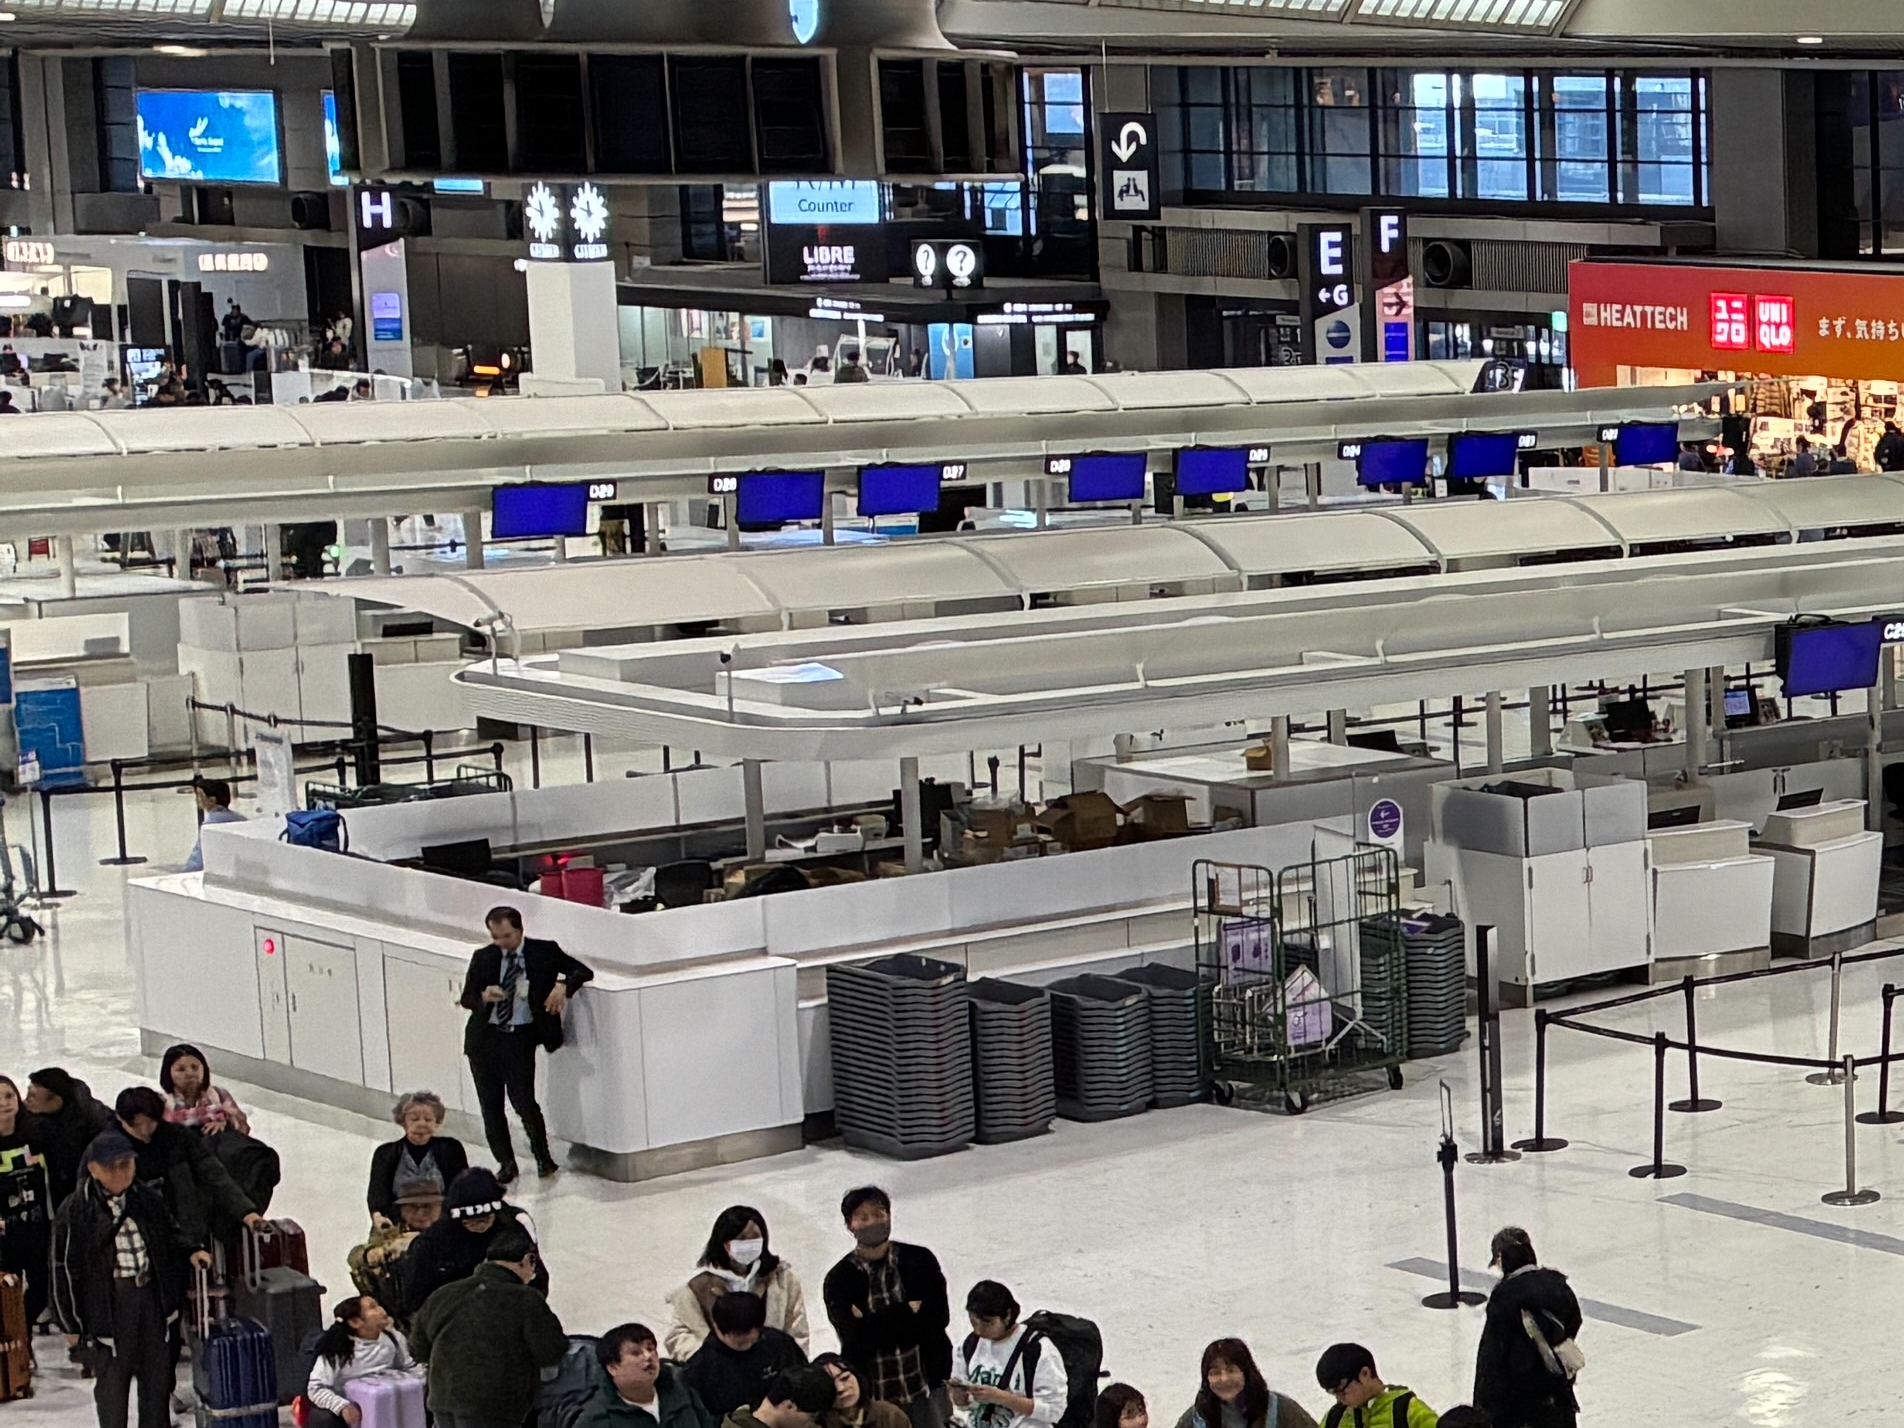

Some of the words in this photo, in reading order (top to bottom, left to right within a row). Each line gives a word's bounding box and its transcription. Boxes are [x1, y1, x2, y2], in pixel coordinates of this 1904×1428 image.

[361, 191, 392, 228] H
[798, 198, 853, 214] Counter
[1380, 215, 1399, 253] F
[803, 245, 855, 264] LIBRE
[1320, 231, 1343, 275] E
[1333, 284, 1348, 305] G
[1600, 302, 1688, 331] HEATTECH
[1715, 300, 1745, 320] ユニ
[1759, 302, 1788, 322] UNI
[1715, 322, 1746, 343] クロ
[1759, 325, 1791, 349] QLO
